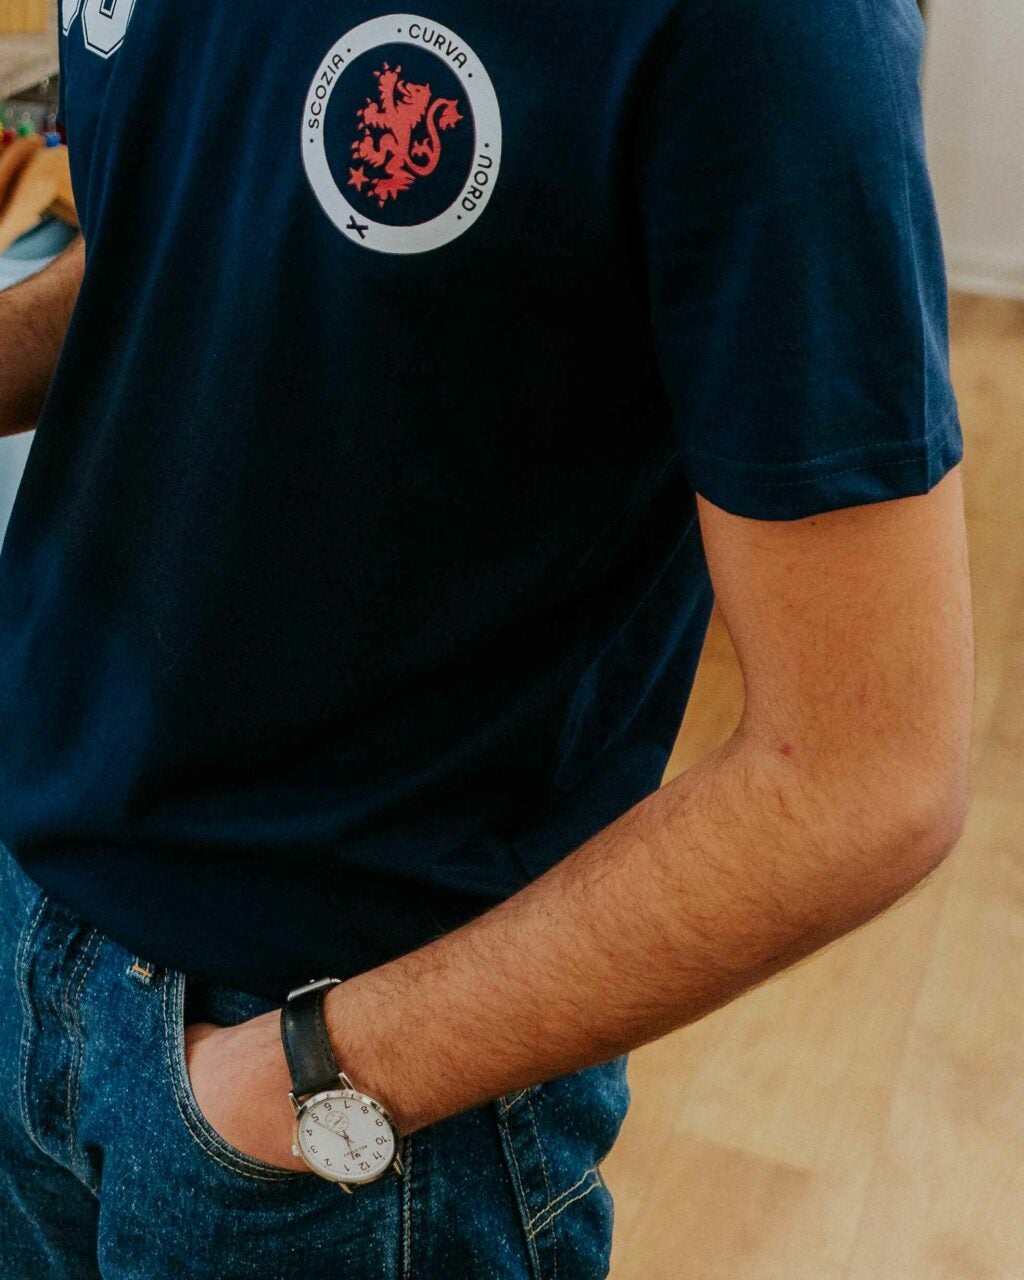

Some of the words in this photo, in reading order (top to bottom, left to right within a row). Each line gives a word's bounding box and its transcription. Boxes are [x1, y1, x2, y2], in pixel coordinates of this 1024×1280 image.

[307, 53, 345, 130] SCOZIA
[407, 22, 469, 71] CURVA
[460, 153, 493, 213] NORD
